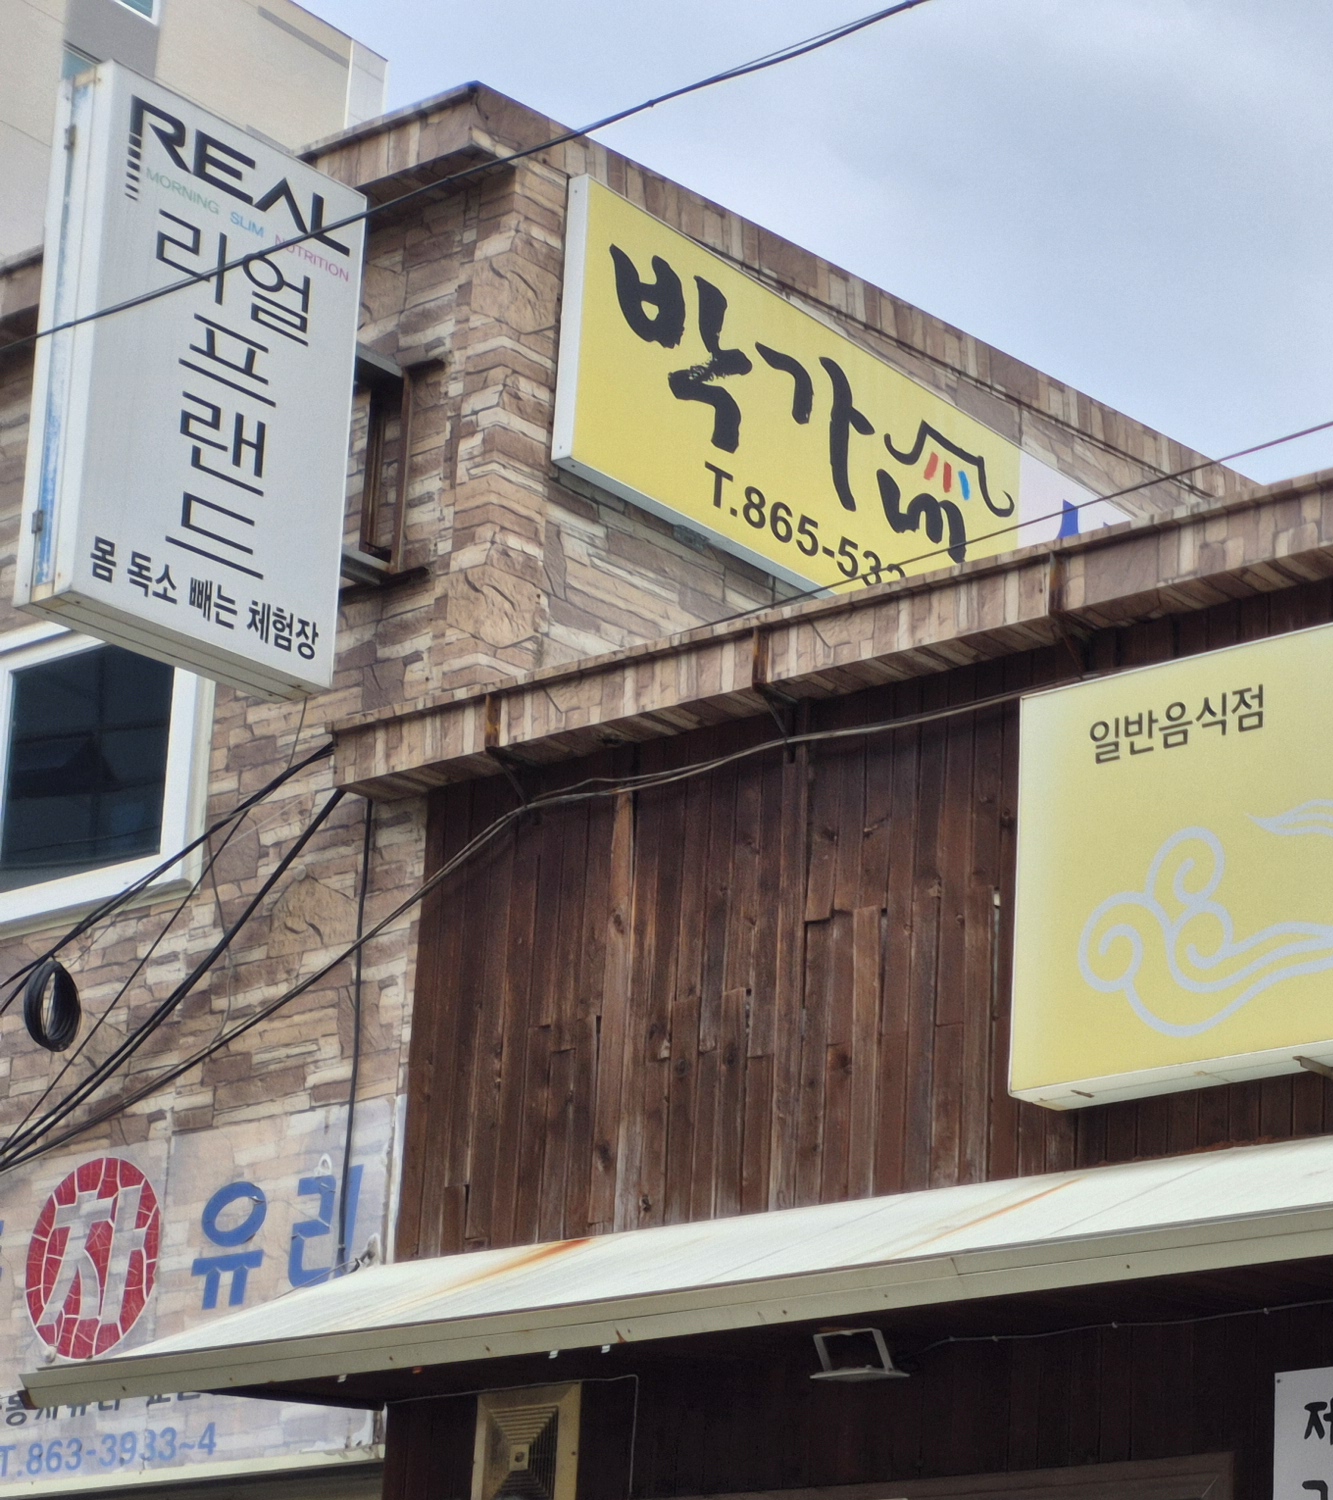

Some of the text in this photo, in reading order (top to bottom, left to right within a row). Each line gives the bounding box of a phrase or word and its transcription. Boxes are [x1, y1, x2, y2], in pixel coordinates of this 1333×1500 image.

[125, 94, 350, 257] REAL
[145, 167, 349, 282] MORNING SLIM NUTRITION
[156, 209, 310, 347] 리얼
[90, 537, 319, 660] 몸 독소 빼는 체험장
[1089, 684, 1265, 765] 일반음식점
[191, 1164, 363, 1309] 유리
